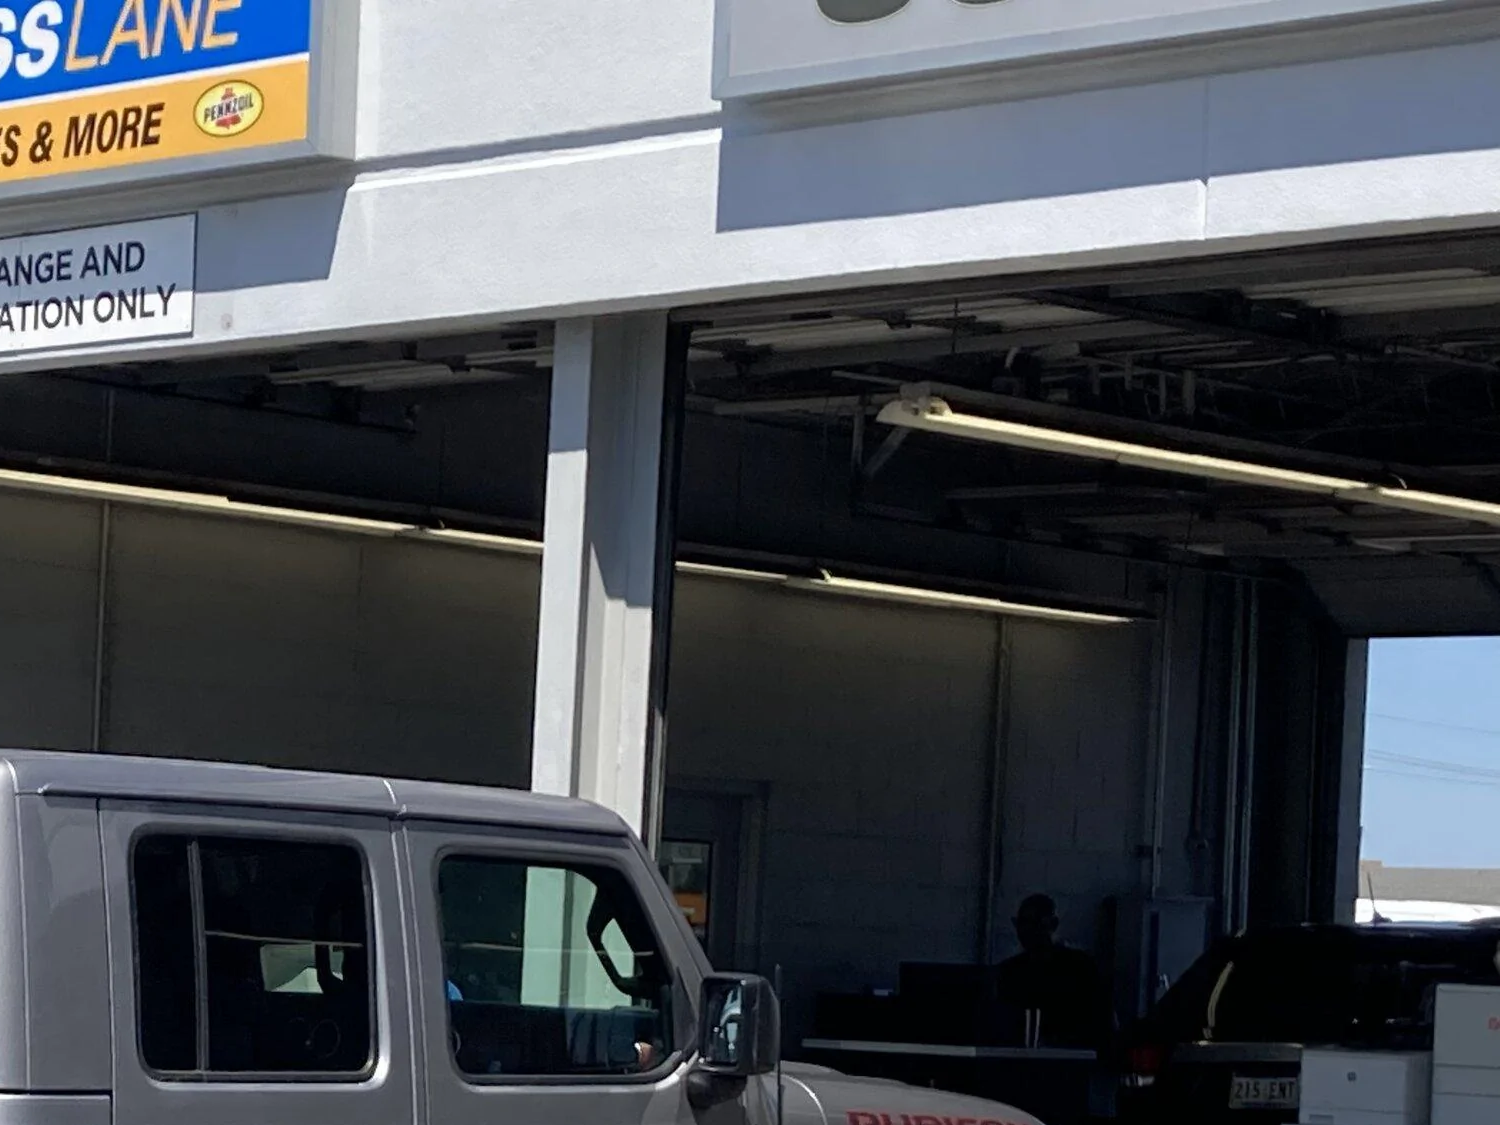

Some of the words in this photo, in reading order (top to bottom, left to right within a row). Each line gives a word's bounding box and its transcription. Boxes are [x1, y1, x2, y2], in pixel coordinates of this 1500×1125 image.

[203, 92, 254, 124] PENNZOIL
[28, 120, 54, 164] &
[63, 102, 166, 158] MORE
[79, 241, 146, 279] AND
[93, 283, 177, 324] ONLY
